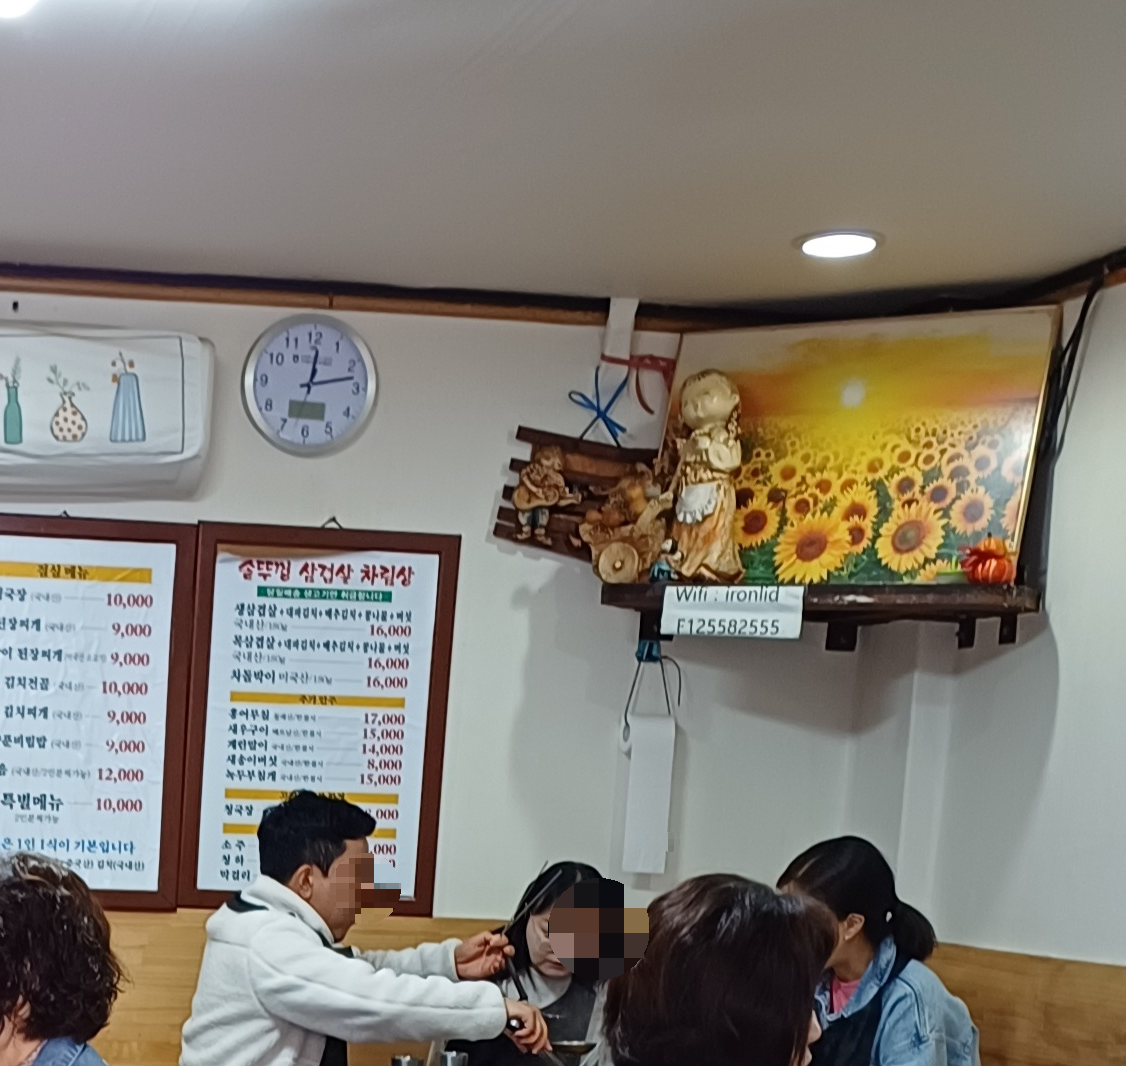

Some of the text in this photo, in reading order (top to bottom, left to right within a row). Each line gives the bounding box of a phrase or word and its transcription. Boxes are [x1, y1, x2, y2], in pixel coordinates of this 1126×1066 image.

[285, 336, 299, 350] 11
[308, 331, 323, 345] 12
[335, 340, 340, 354] 1
[269, 352, 284, 366] 10
[348, 359, 356, 373] 2
[260, 374, 268, 387] 9
[352, 382, 360, 395] 3
[265, 400, 273, 412] 8
[343, 406, 350, 418] 4
[280, 418, 287, 431] 7
[301, 425, 309, 438] 6
[325, 421, 332, 434] 5
[106, 593, 154, 609] 10,000
[111, 622, 153, 638] 9,000
[369, 624, 412, 638] 16,000
[110, 651, 151, 667] 9,000
[367, 657, 410, 670] 16,000
[101, 681, 149, 697] 10,000
[366, 675, 408, 690] 16,000
[106, 710, 147, 726] 9,000
[363, 712, 406, 726] 17,000
[362, 728, 405, 742] 15,000
[105, 739, 146, 755] 9,000
[361, 744, 404, 757] 14,000
[367, 759, 403, 773] 8,000
[96, 768, 145, 784] 12,000
[359, 773, 402, 788] 15,000
[0, 792, 65, 812] 특별메뉴
[95, 798, 144, 813] 10,000
